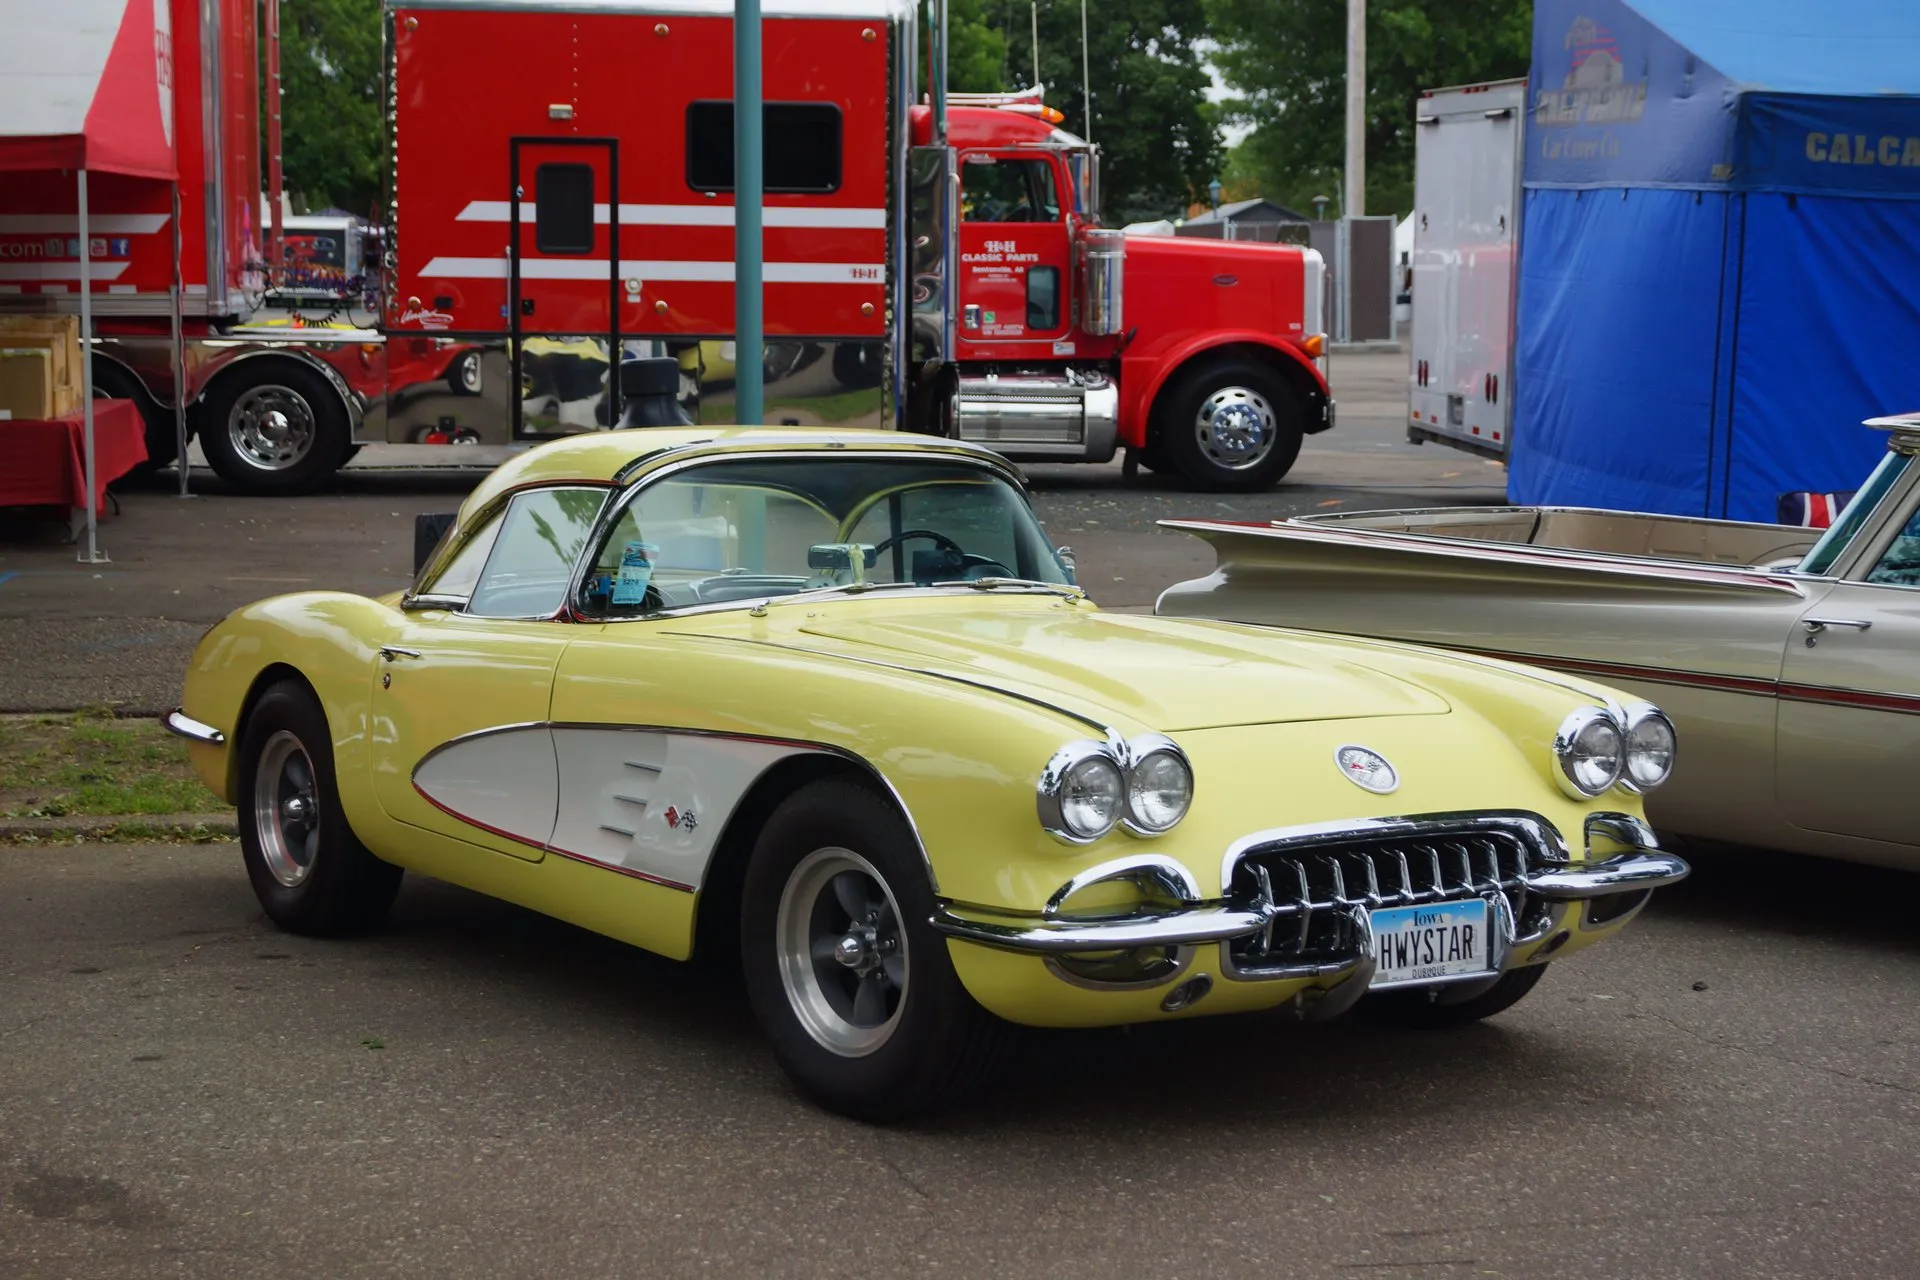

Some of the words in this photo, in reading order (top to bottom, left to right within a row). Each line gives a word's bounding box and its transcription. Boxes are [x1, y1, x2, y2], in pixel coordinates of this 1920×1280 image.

[961, 253, 1003, 262] CLASSIC
[1006, 253, 1039, 262] PARTS
[1381, 924, 1473, 970] HWYSTAR
[1412, 965, 1446, 978] DUBUQUE
